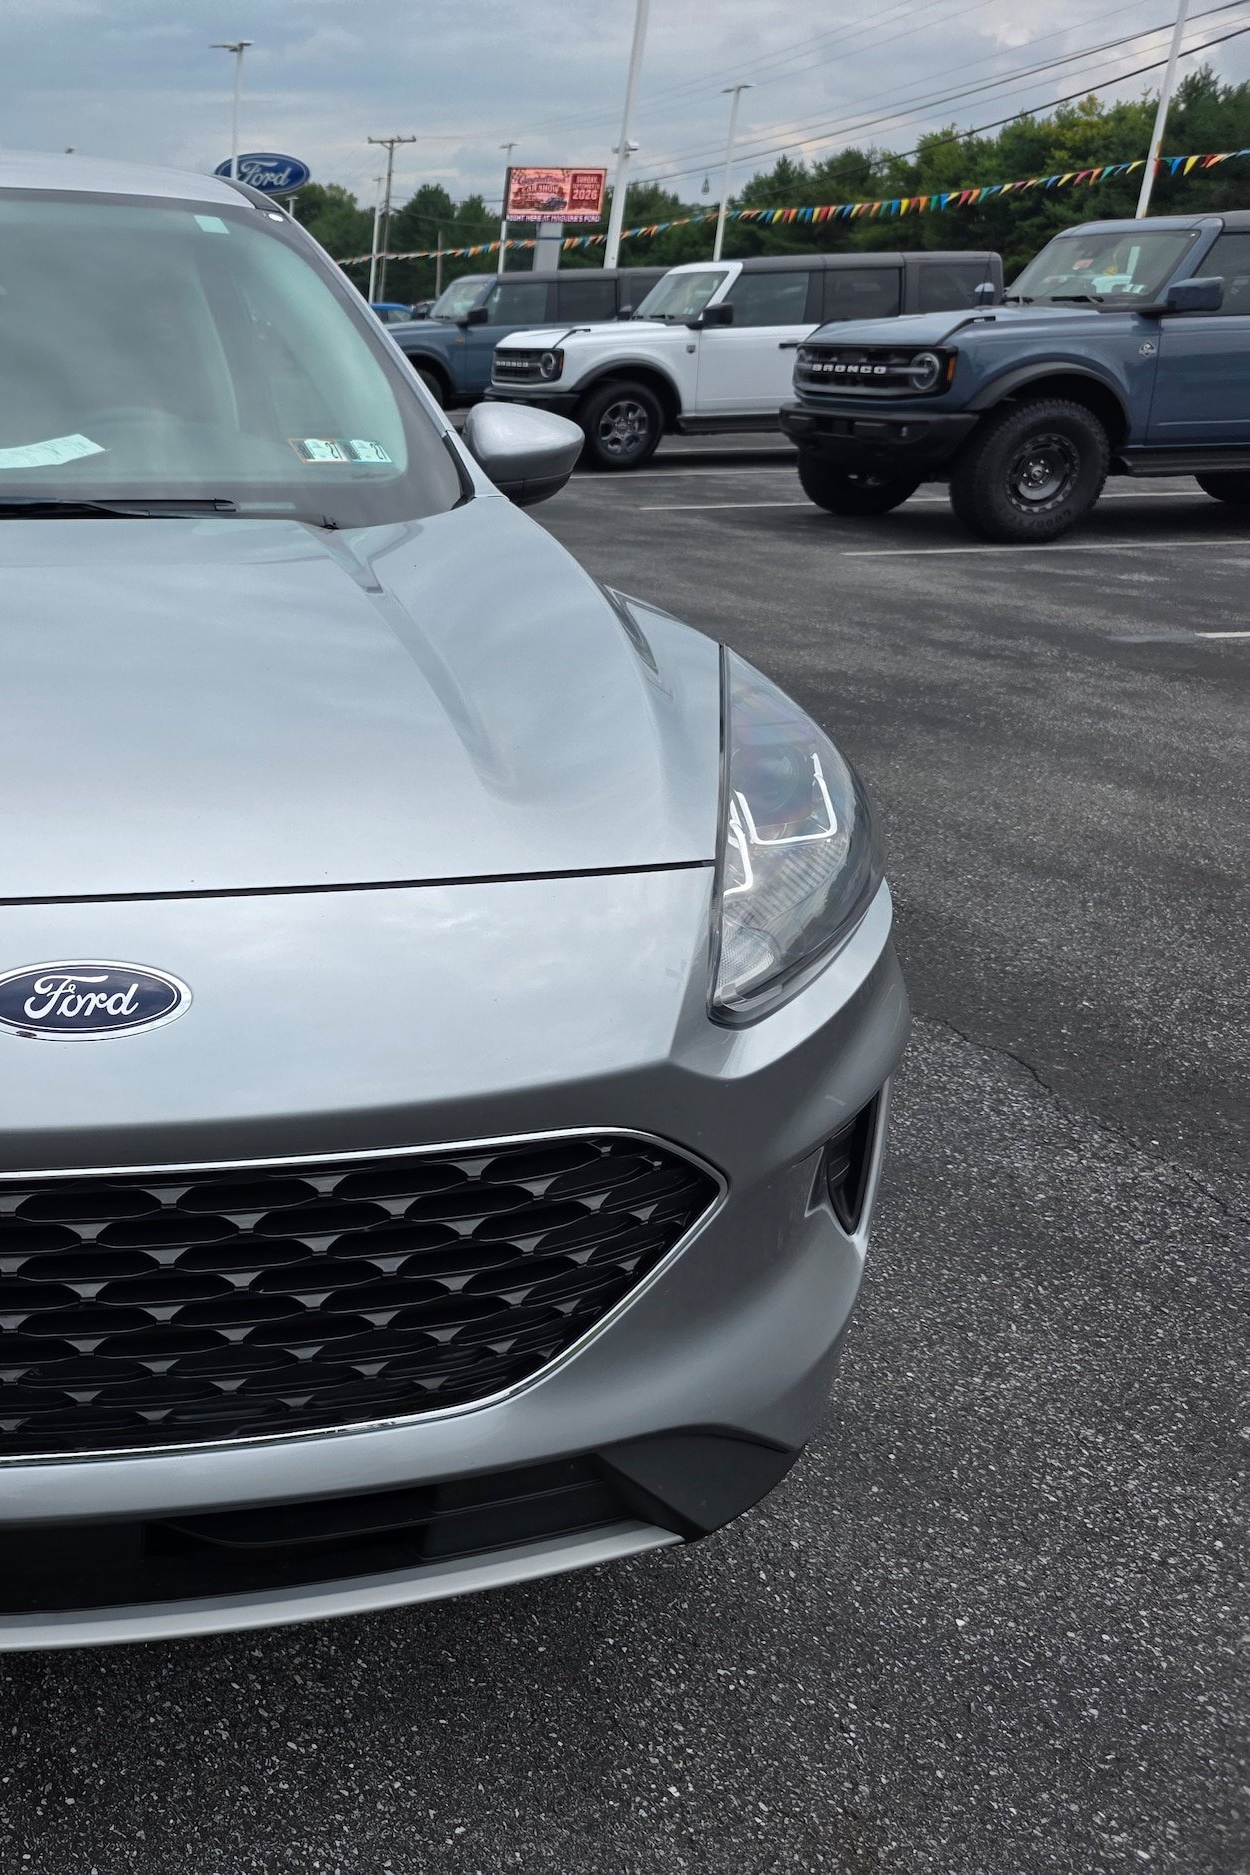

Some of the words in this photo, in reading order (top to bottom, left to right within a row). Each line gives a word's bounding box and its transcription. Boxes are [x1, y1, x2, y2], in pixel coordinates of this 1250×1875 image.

[237, 160, 292, 187] Ford
[572, 190, 598, 200] 2026
[812, 363, 887, 375] BRONCO
[23, 975, 139, 1019] Ford
